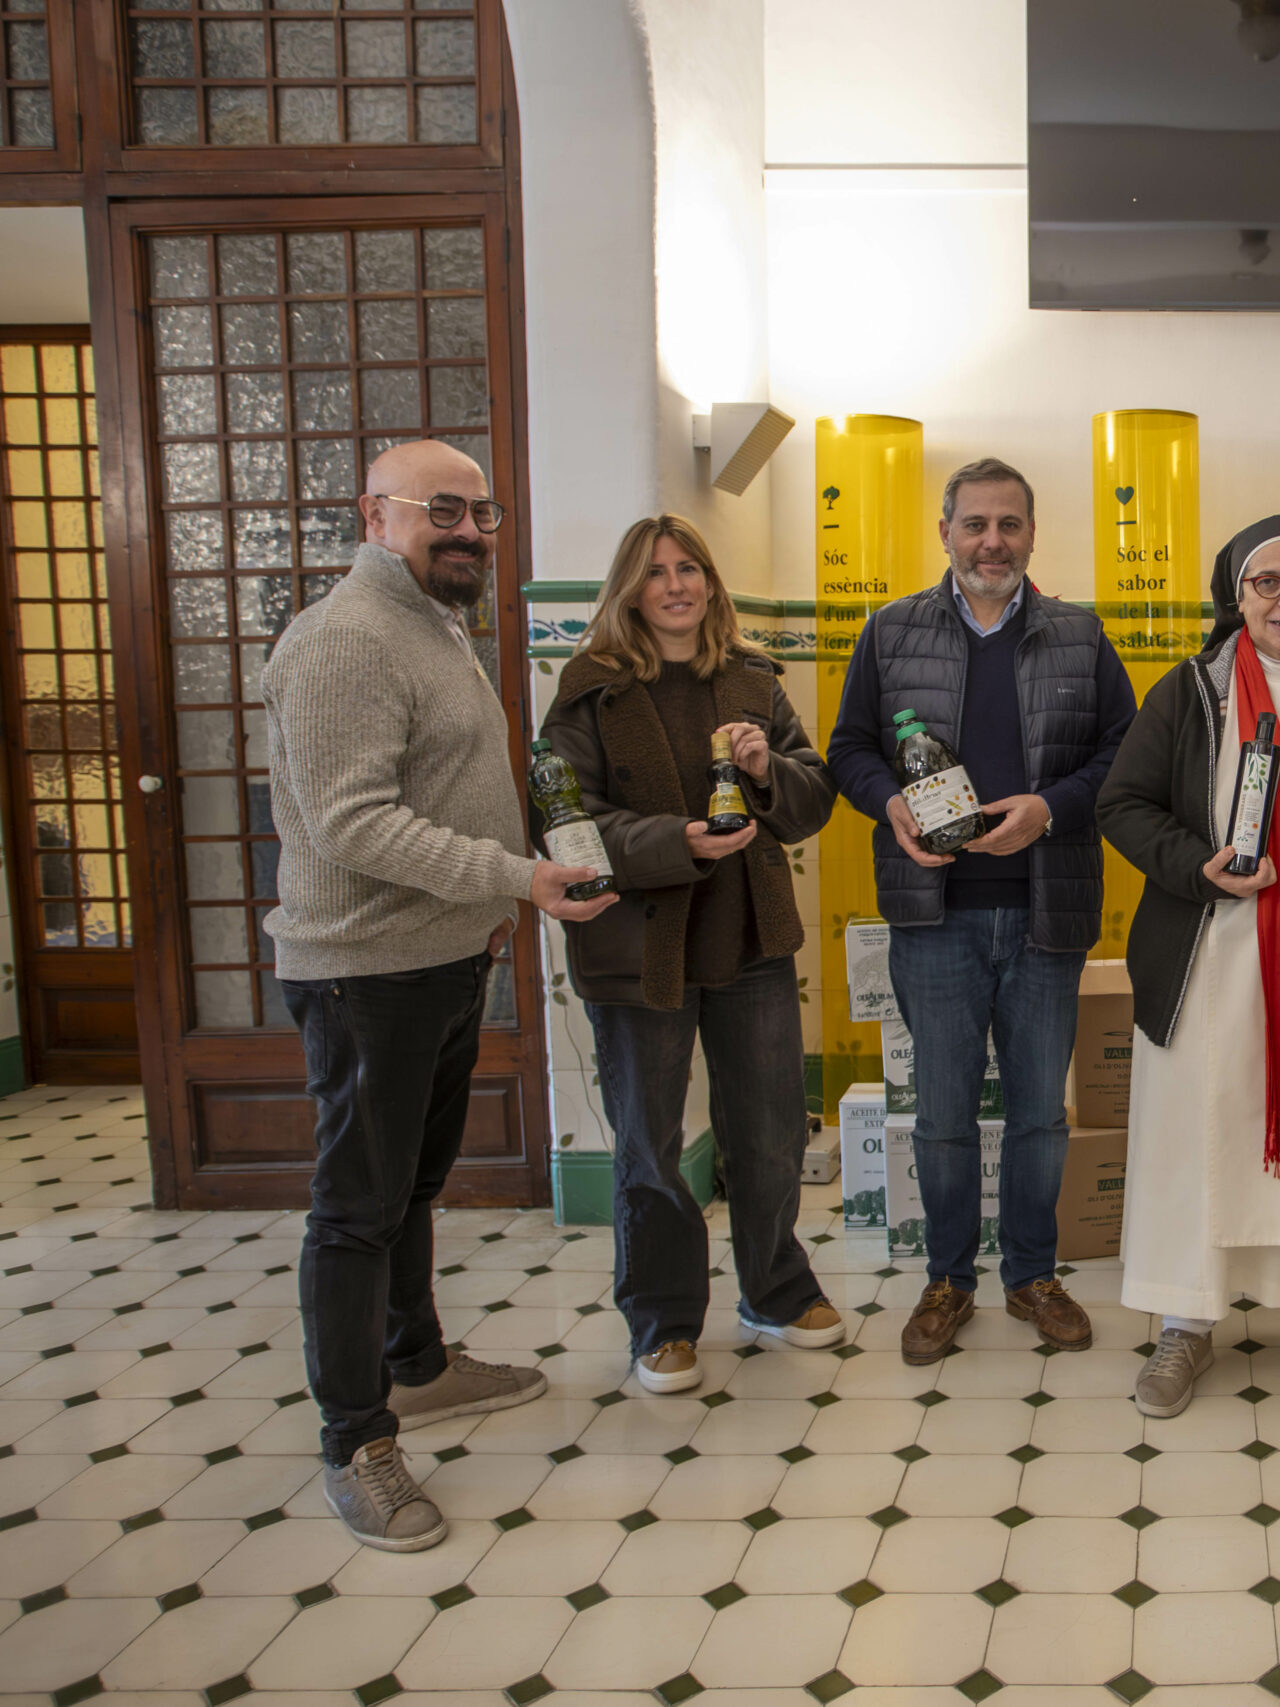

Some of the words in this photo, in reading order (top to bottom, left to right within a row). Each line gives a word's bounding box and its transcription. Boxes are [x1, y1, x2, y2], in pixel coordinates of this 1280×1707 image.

[824, 549, 848, 566] Sóc
[1117, 545, 1147, 562] Sóc
[1154, 545, 1169, 561] el
[824, 576, 888, 594] essència
[1117, 574, 1166, 591] sabor
[824, 605, 856, 621] d'un
[1119, 603, 1138, 619] de
[1145, 602, 1160, 618] la
